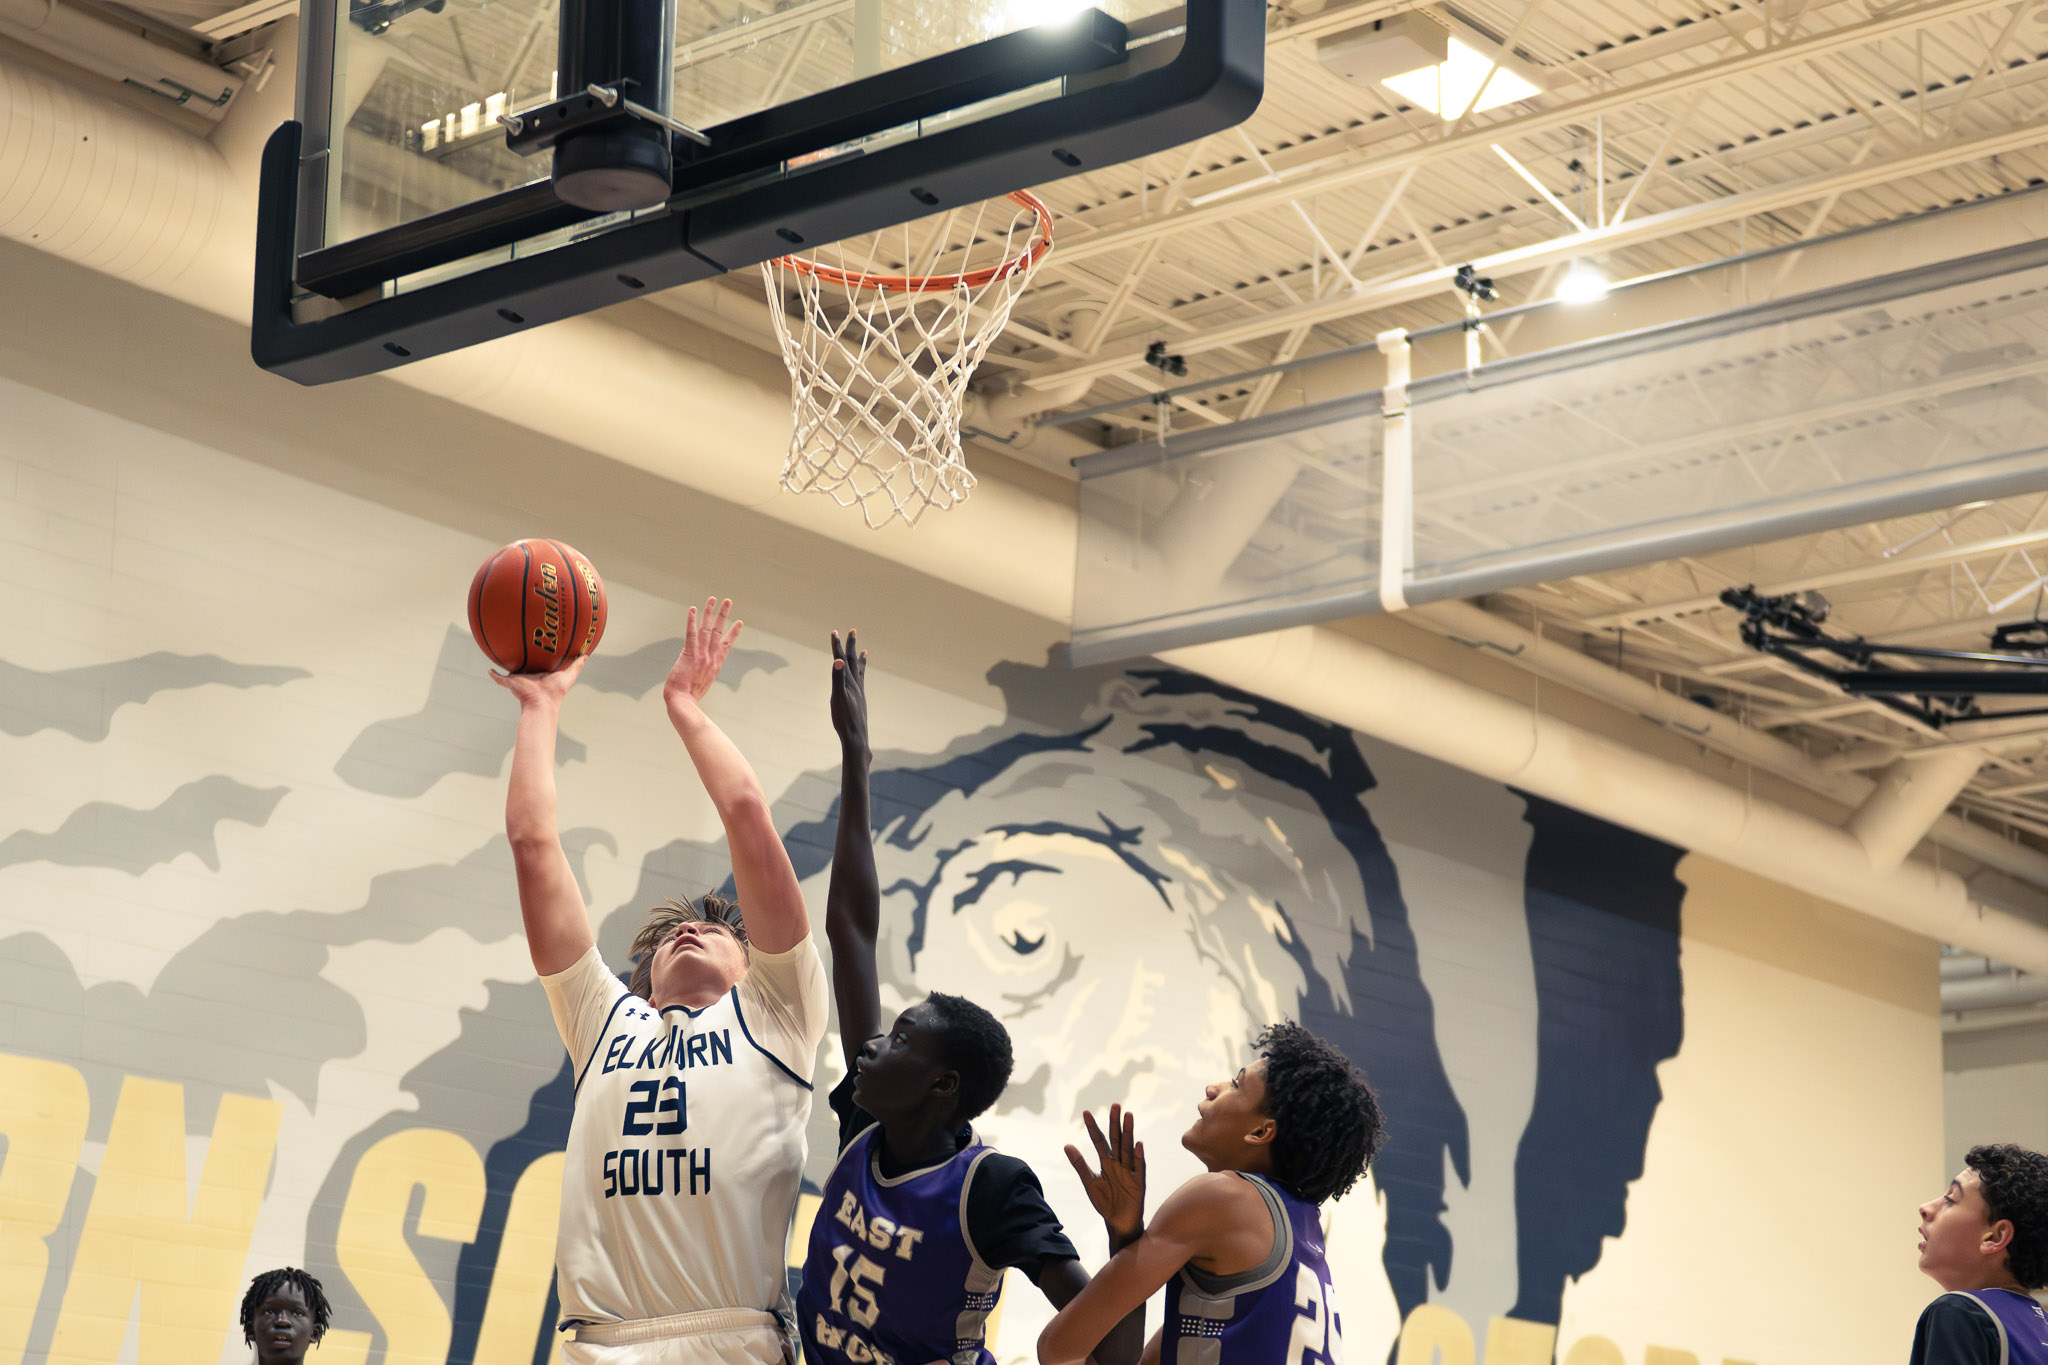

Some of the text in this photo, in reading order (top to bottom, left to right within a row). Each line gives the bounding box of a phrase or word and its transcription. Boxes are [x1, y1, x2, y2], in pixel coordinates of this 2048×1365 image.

[533, 562, 559, 655] Baden
[622, 1075, 688, 1136] 23
[603, 1147, 711, 1199] SOUTH
[834, 1189, 925, 1261] EAST
[829, 1244, 886, 1330] 15
